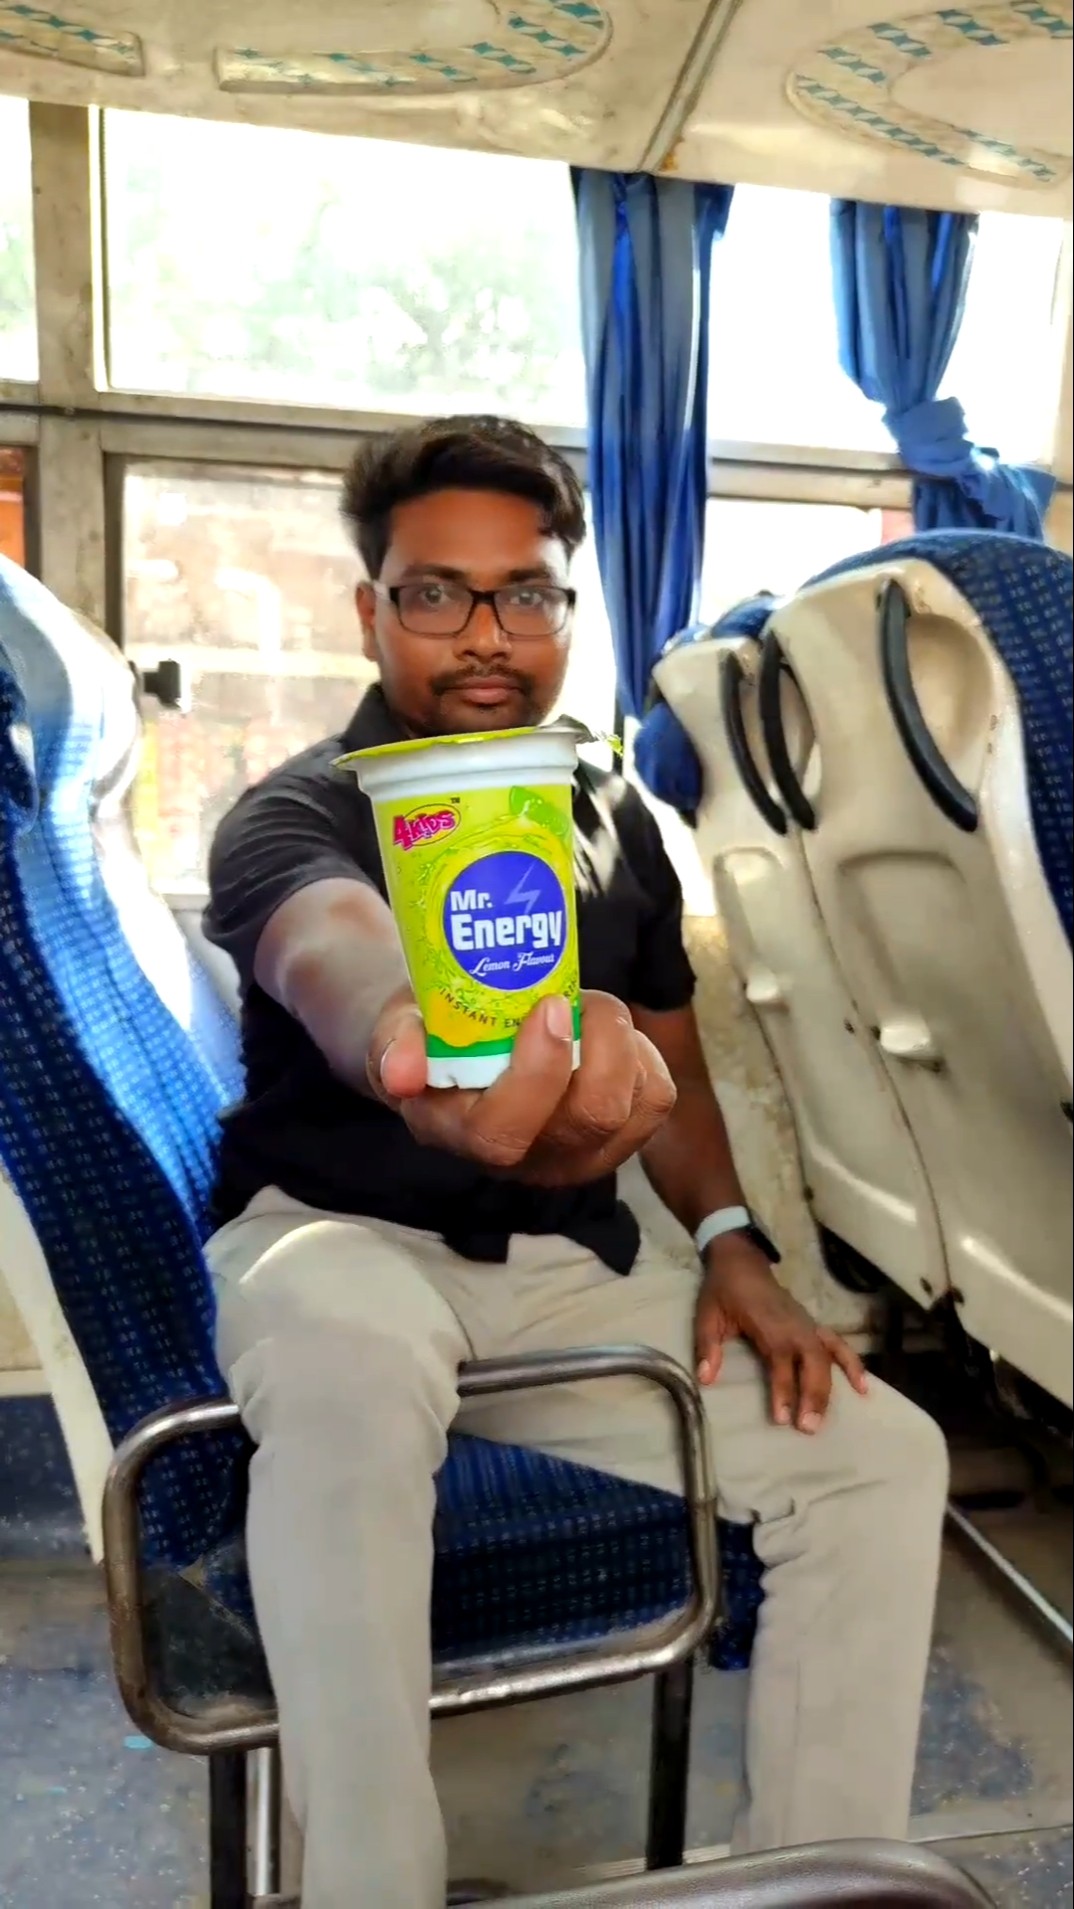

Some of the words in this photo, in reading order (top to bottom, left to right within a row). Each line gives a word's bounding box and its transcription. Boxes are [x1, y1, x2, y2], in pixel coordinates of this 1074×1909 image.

[450, 889, 493, 911] Mr.
[450, 910, 562, 951] Energy
[469, 957, 511, 977] Lemon
[440, 987, 497, 1026] INSTANT
